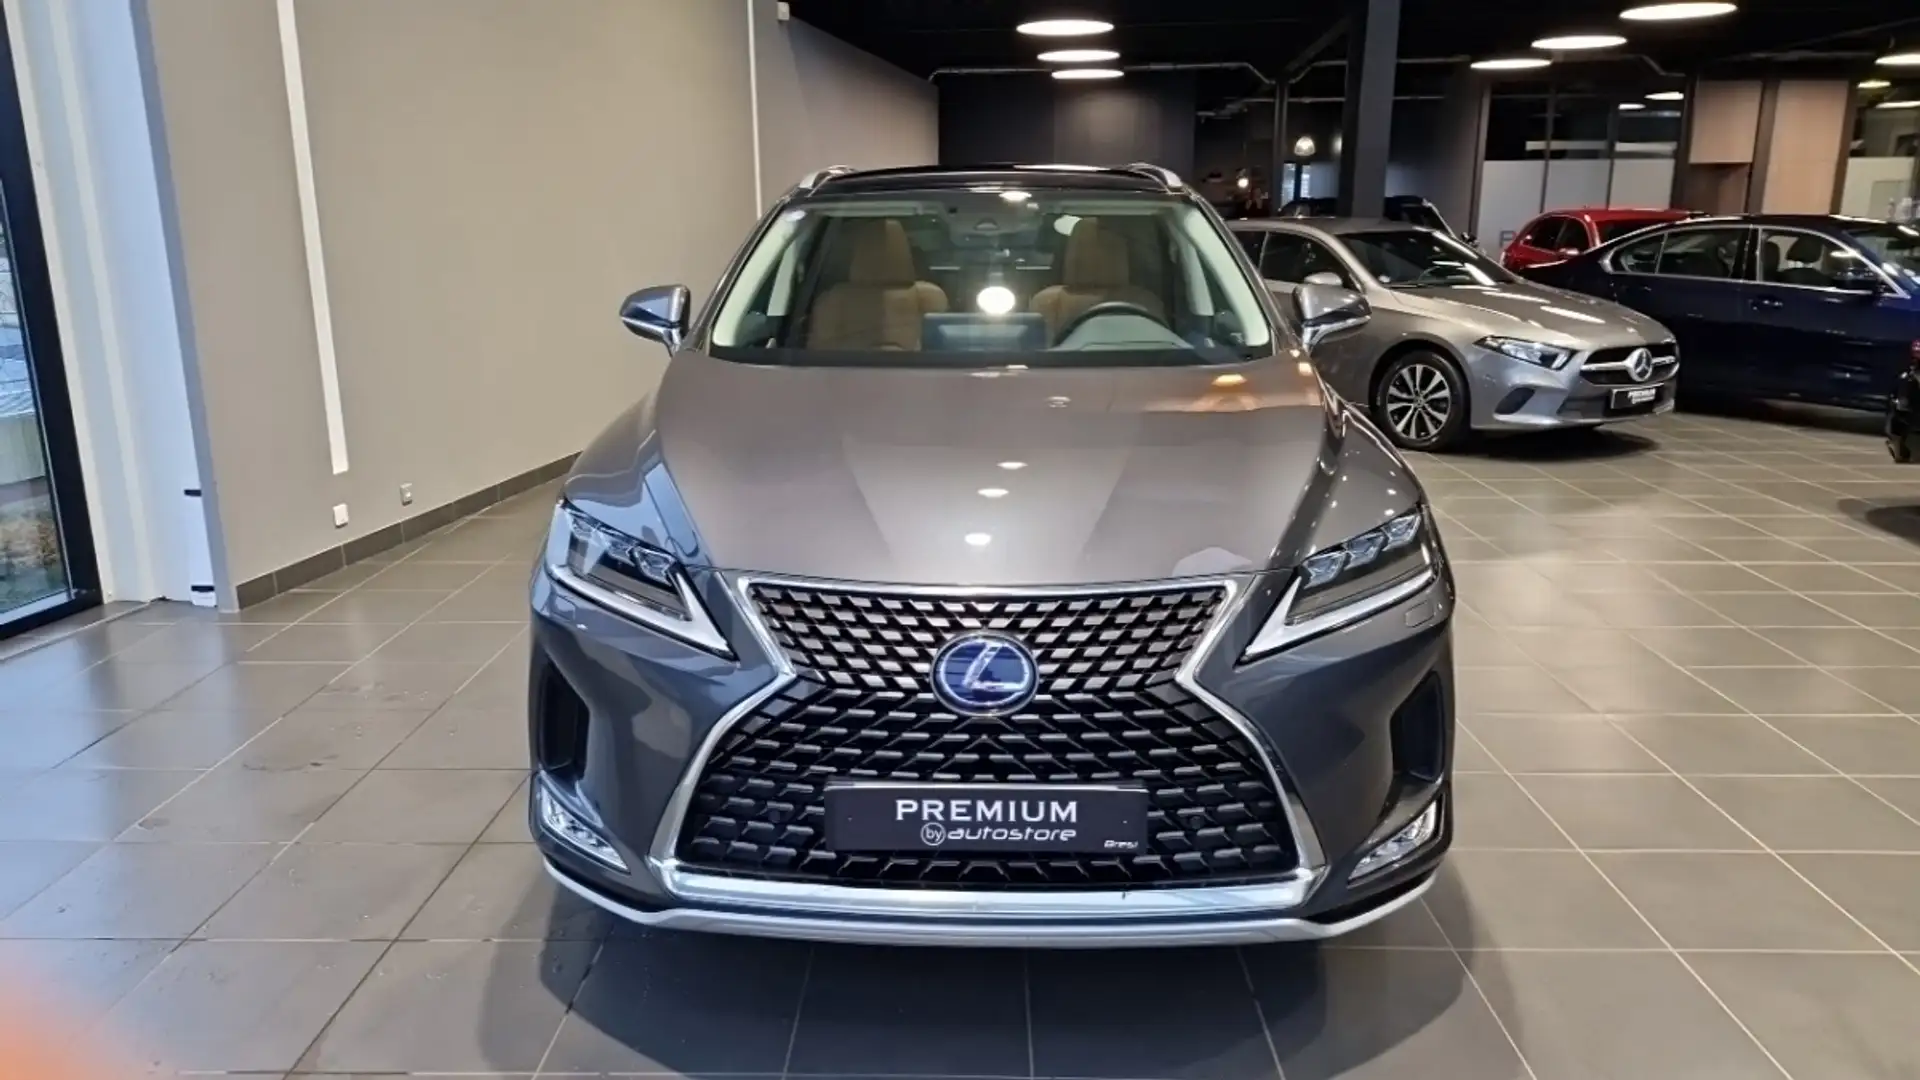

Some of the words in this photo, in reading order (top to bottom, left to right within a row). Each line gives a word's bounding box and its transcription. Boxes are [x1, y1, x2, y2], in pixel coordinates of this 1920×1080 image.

[895, 799, 1078, 823] PREMIUM
[924, 825, 944, 843] by
[947, 826, 1077, 842] autostore
